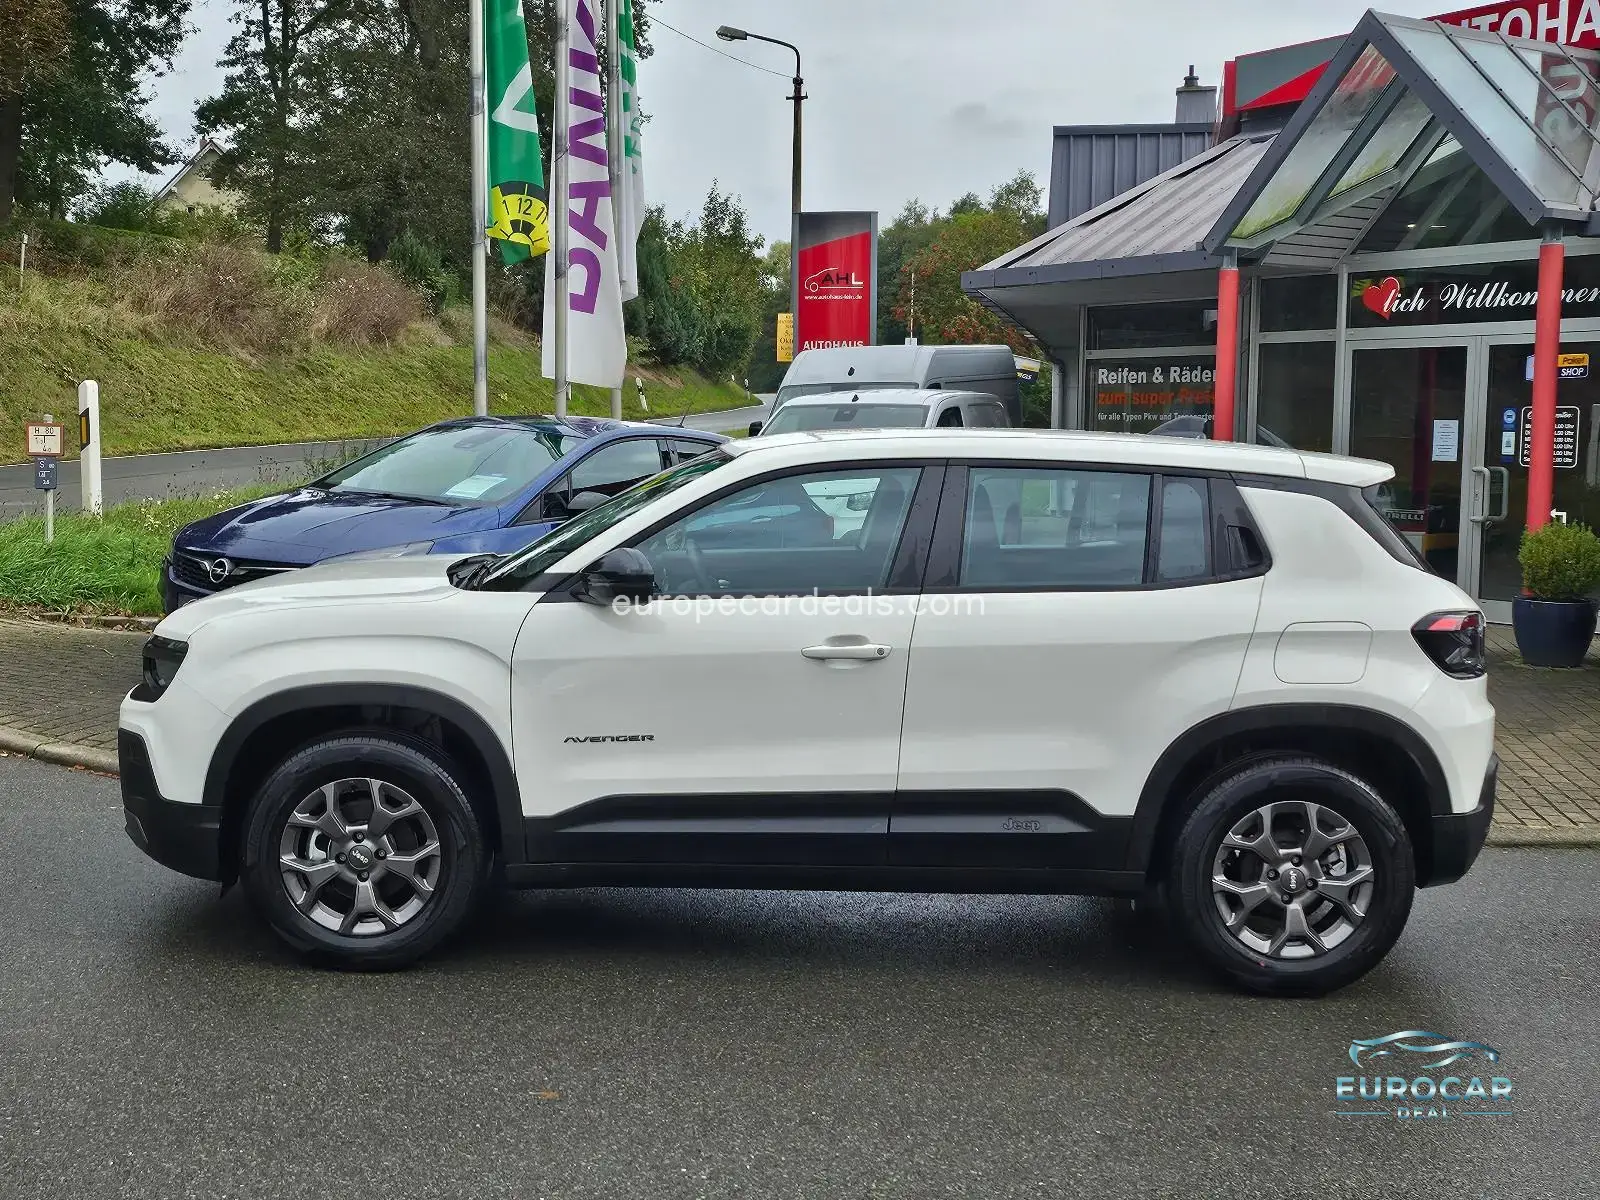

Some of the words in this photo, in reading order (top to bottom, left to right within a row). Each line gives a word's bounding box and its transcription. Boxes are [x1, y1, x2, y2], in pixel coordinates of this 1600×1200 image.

[517, 197, 533, 216] 12
[822, 272, 863, 285] AHL
[803, 340, 864, 350] AUTOHAUS
[1098, 368, 1146, 384] Reifen
[1152, 366, 1164, 383] &
[1560, 367, 1584, 377] SHOP
[1098, 392, 1127, 404] zum
[1133, 391, 1175, 406] super
[1098, 412, 1107, 421] für
[1108, 412, 1120, 421] alle
[1122, 412, 1141, 422] Typen
[1143, 412, 1158, 420] Pkw
[1160, 412, 1172, 420] und
[564, 734, 655, 743] AVENGER
[1000, 817, 1041, 832] Jeep
